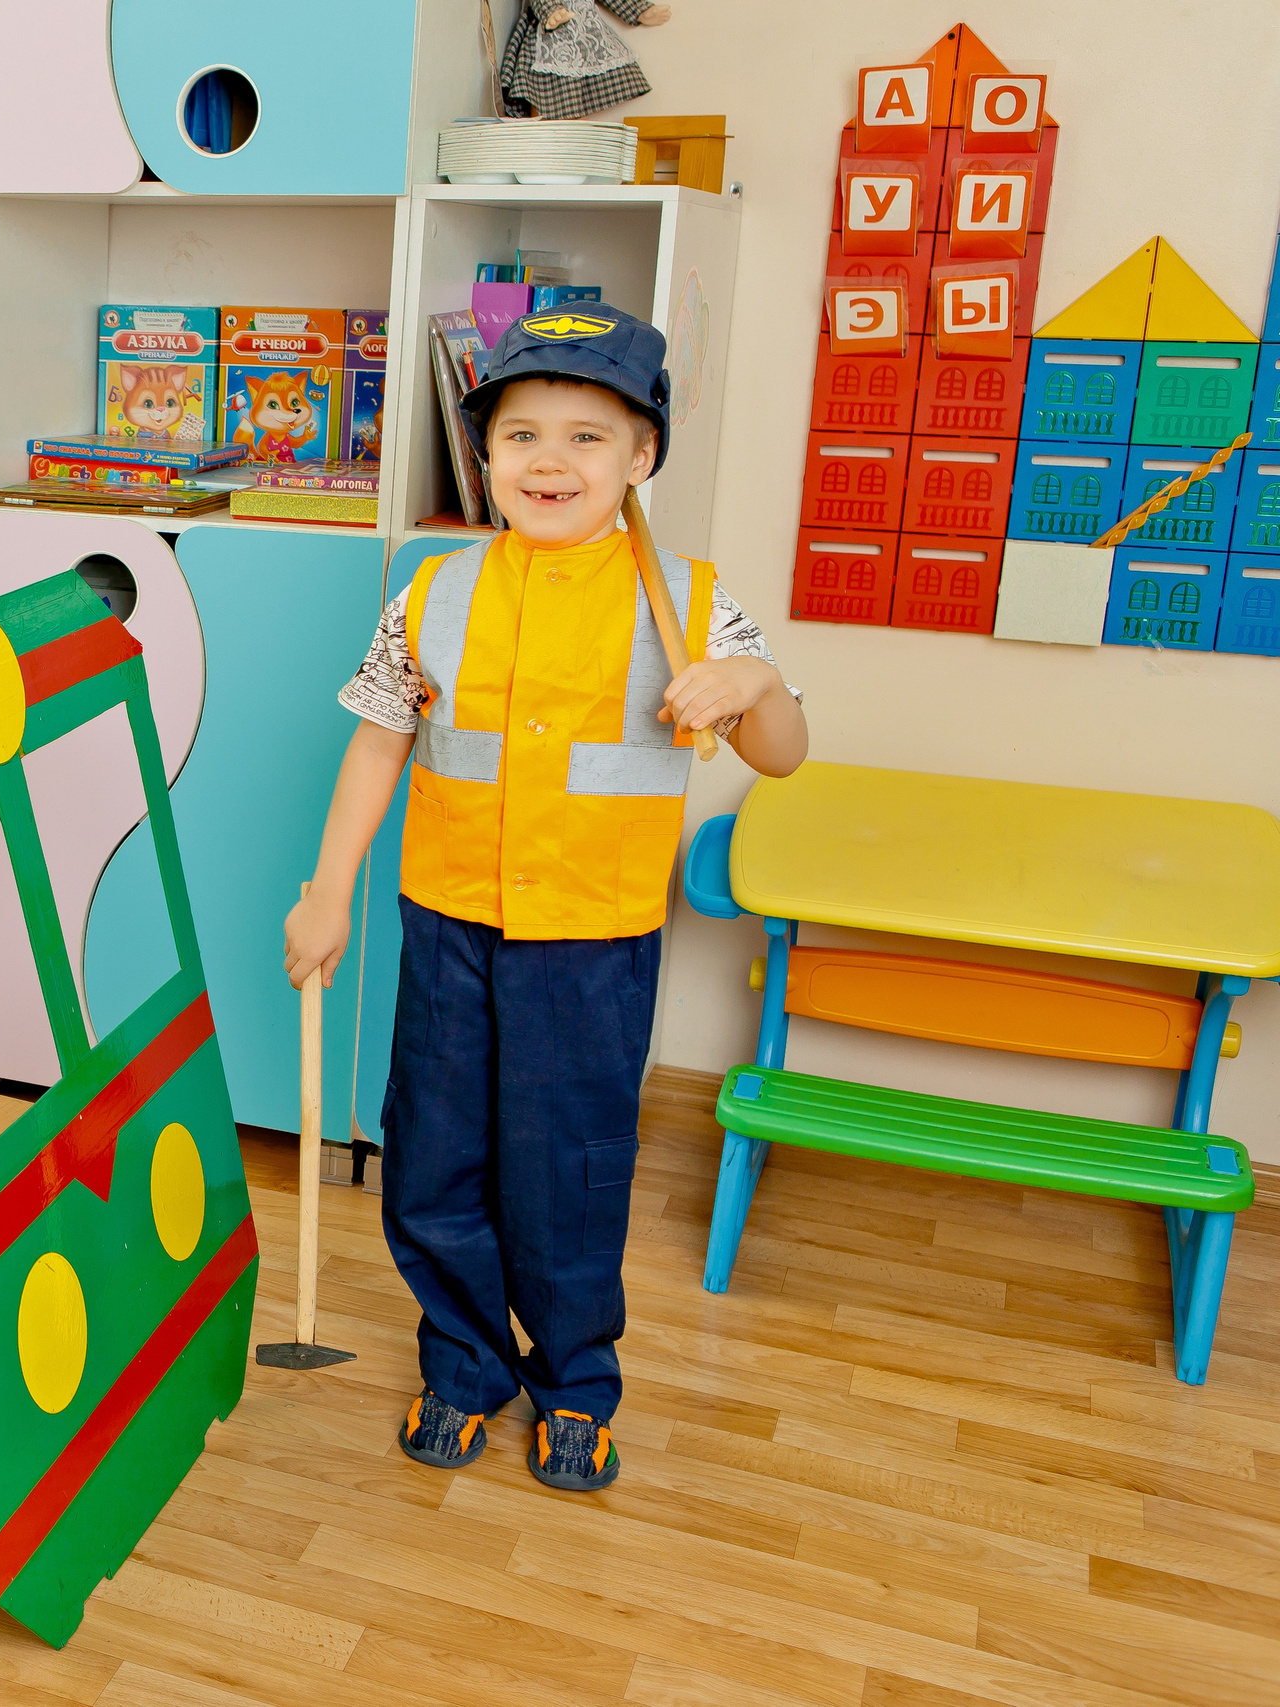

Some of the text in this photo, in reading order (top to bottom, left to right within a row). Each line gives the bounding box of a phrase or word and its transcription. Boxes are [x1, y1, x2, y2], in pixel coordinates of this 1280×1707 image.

[878, 78, 916, 118] А
[984, 85, 1027, 126] О
[862, 184, 903, 224] У
[971, 182, 1013, 223] И
[848, 298, 885, 333] Э
[951, 285, 1001, 325] Ы
[127, 334, 188, 350] АЗБУКА
[252, 338, 307, 351] РЕЧЕВОЙ
[44, 443, 58, 453] ЧТО
[59, 445, 93, 457] СНАЧАЛА,
[93, 447, 108, 458] ЧТО
[109, 449, 142, 461] ПОТОМ?
[331, 479, 373, 491] ЛОГОПЕД
[373, 702, 387, 711] OUT
